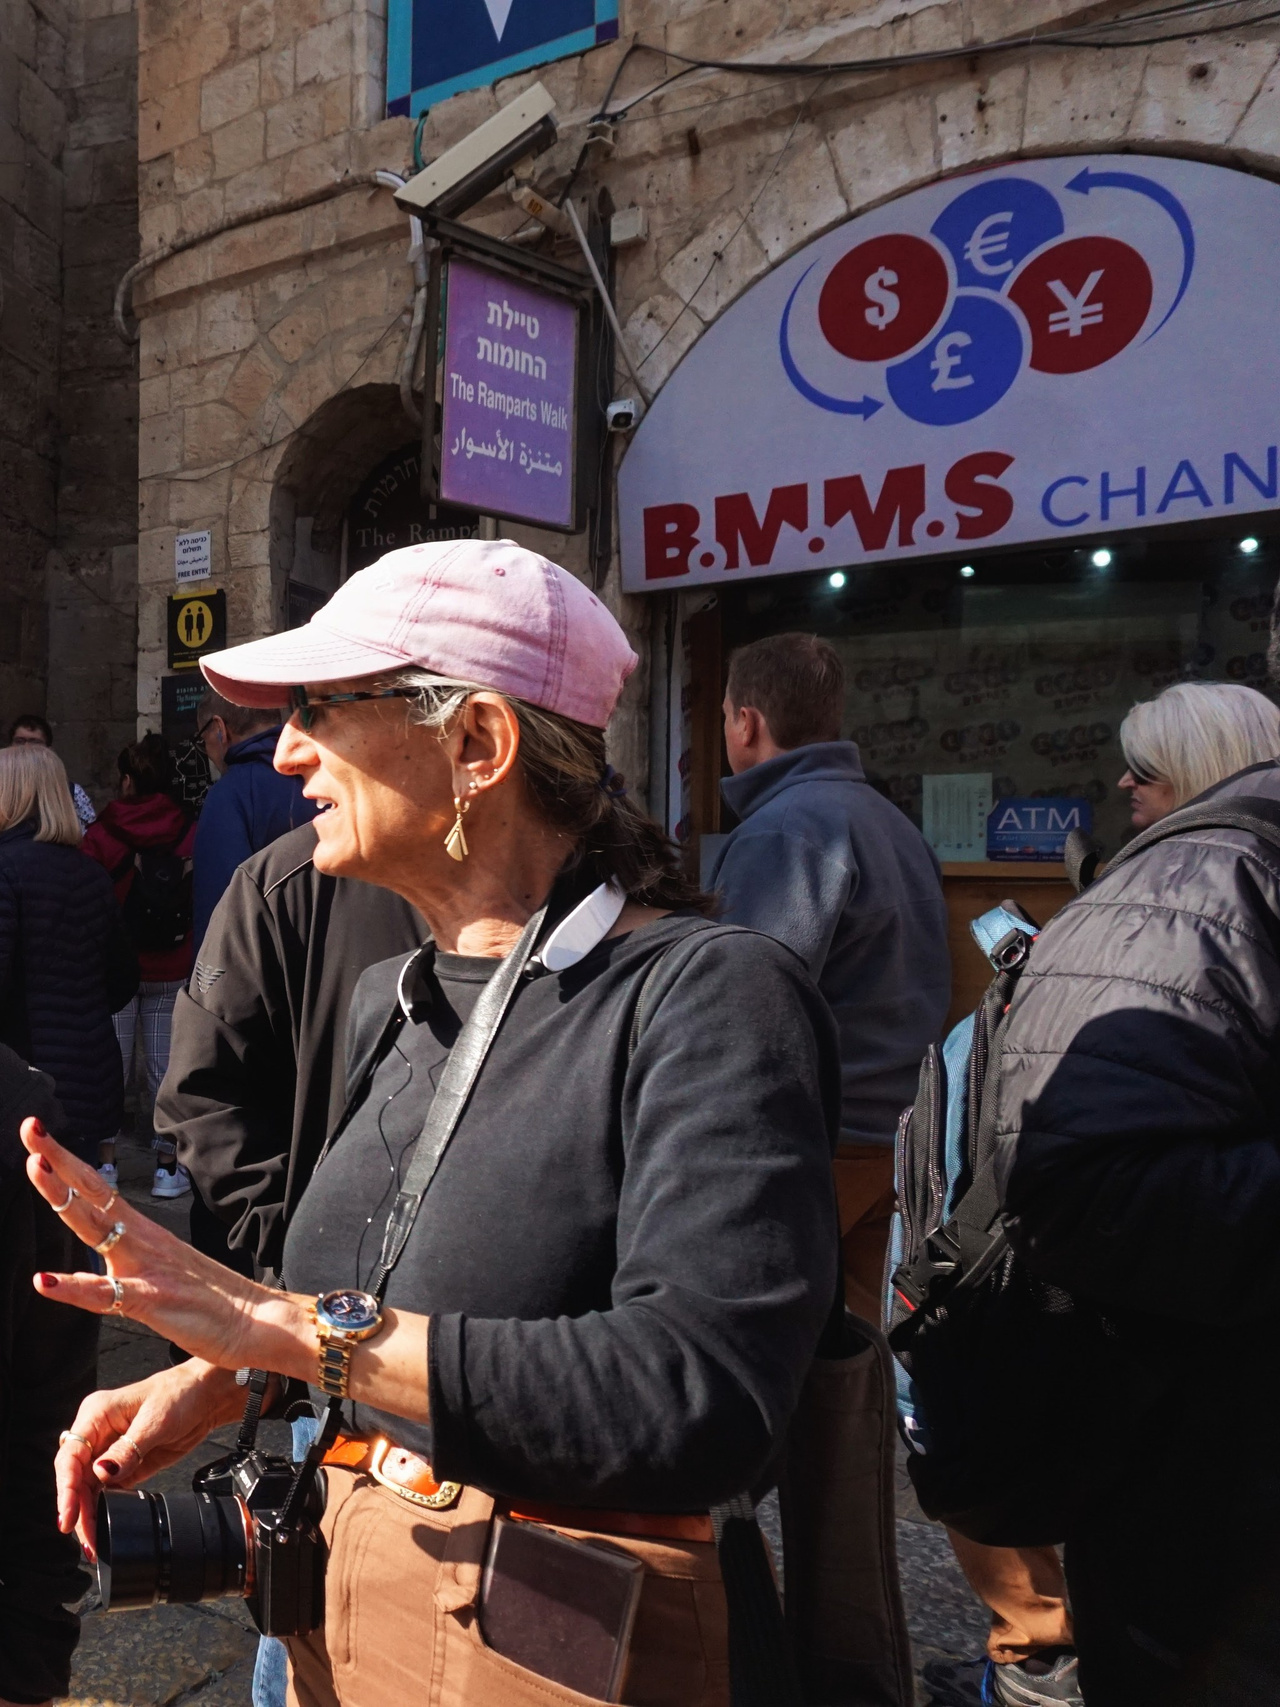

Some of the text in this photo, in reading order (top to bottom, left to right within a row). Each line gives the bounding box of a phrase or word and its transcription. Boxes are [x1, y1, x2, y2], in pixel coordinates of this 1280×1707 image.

[487, 300, 540, 339] טיילת
[476, 336, 547, 381] החומות
[450, 372, 568, 431] The Ramparts Walk
[450, 426, 515, 463] الأسوار
[1040, 444, 1279, 528] CHAN
[356, 525, 396, 548] The
[177, 567, 209, 579] FREE ENTRY
[997, 806, 1082, 831] ATM
